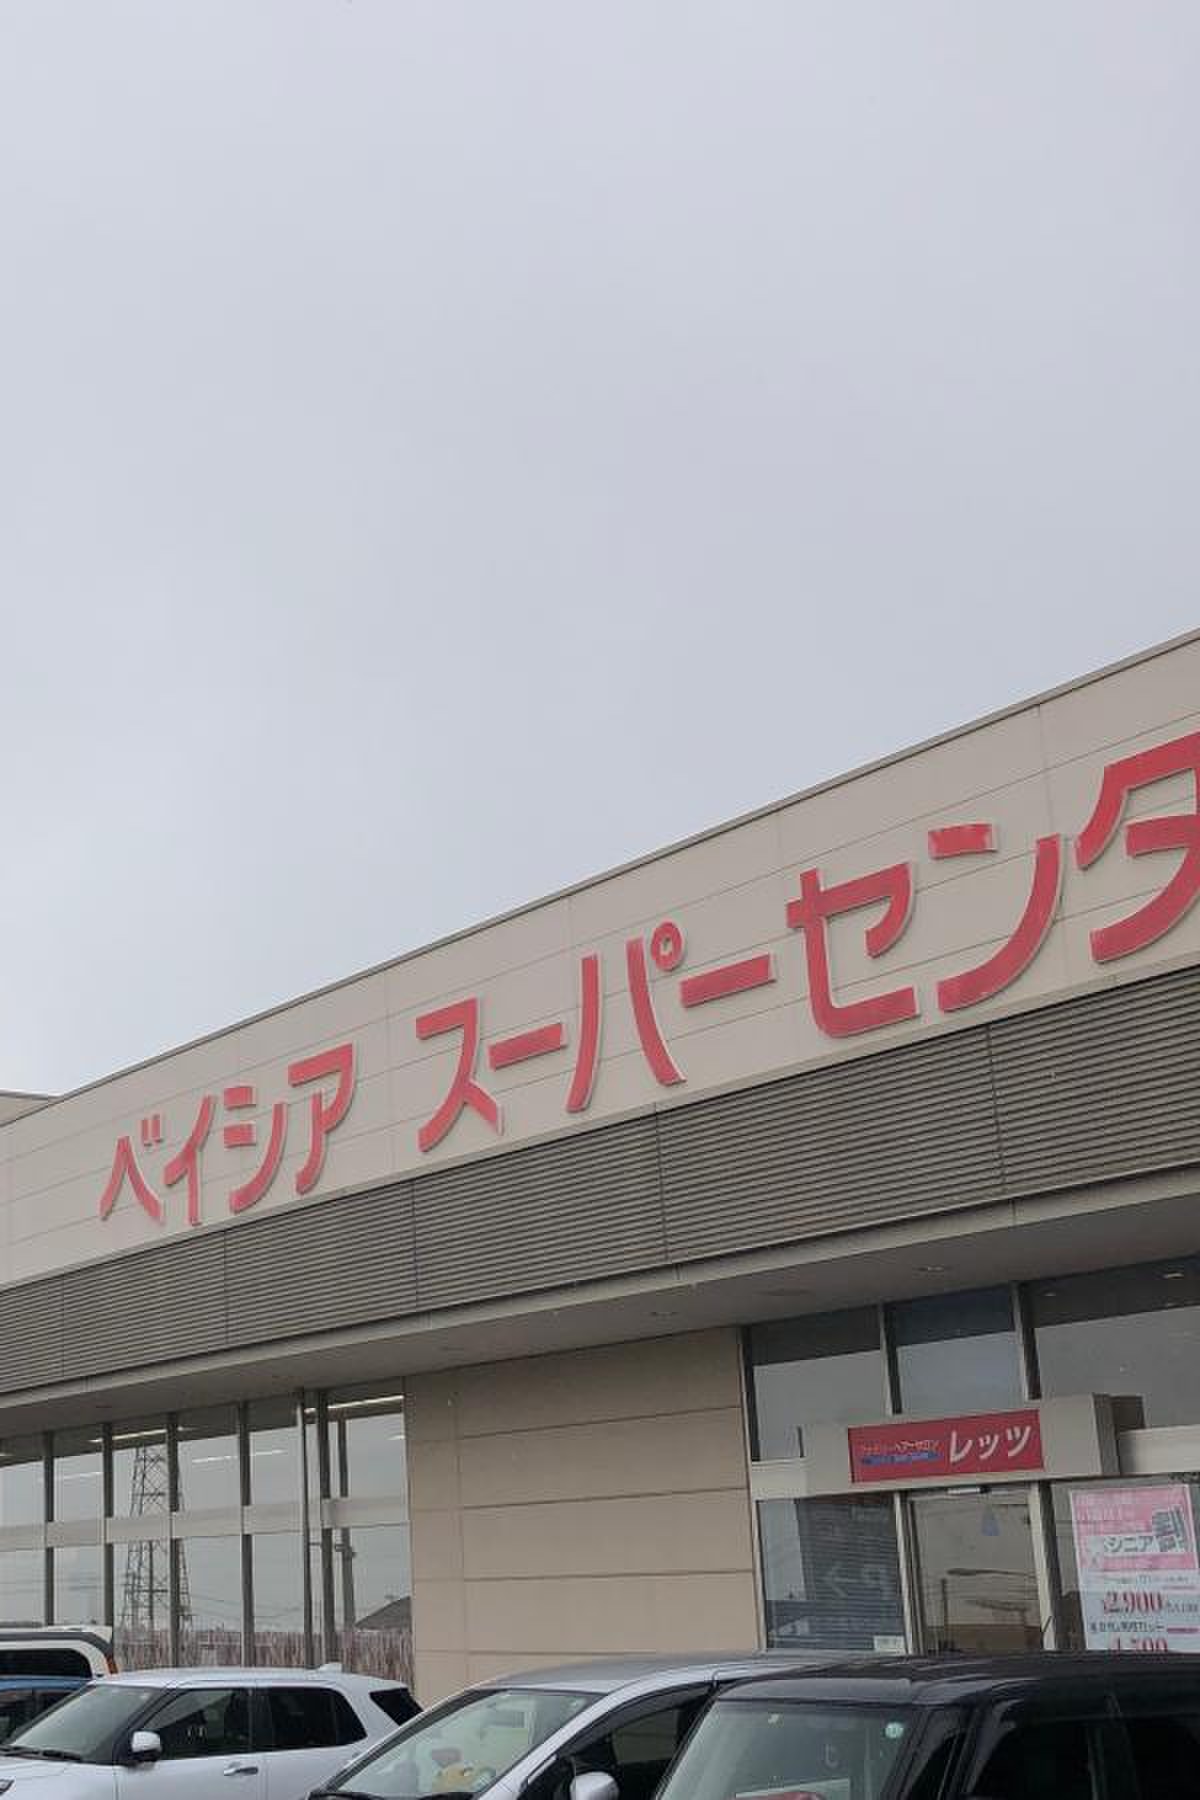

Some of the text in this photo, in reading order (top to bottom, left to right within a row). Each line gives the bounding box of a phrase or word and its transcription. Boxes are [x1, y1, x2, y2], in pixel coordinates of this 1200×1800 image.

[99, 1042, 356, 1227] ベイシア
[949, 1425, 1032, 1463] レッツ
